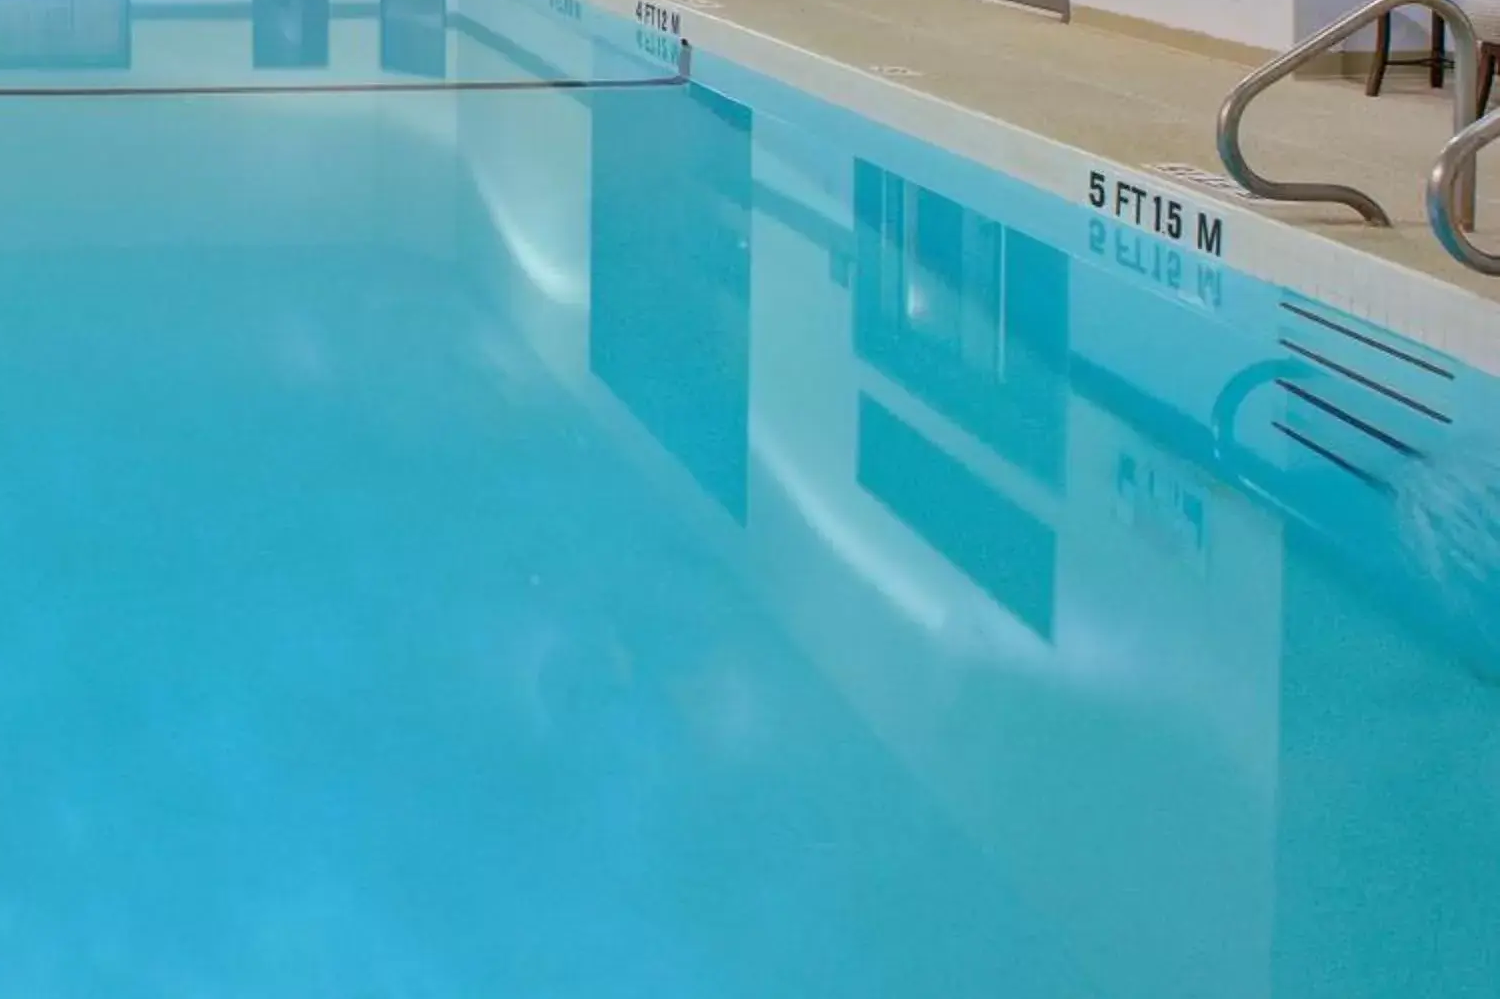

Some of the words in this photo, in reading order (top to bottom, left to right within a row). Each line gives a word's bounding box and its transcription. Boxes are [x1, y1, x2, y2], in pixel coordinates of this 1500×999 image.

[635, 0, 642, 21] 4
[1089, 170, 1105, 208] 5
[1197, 213, 1222, 257] M
